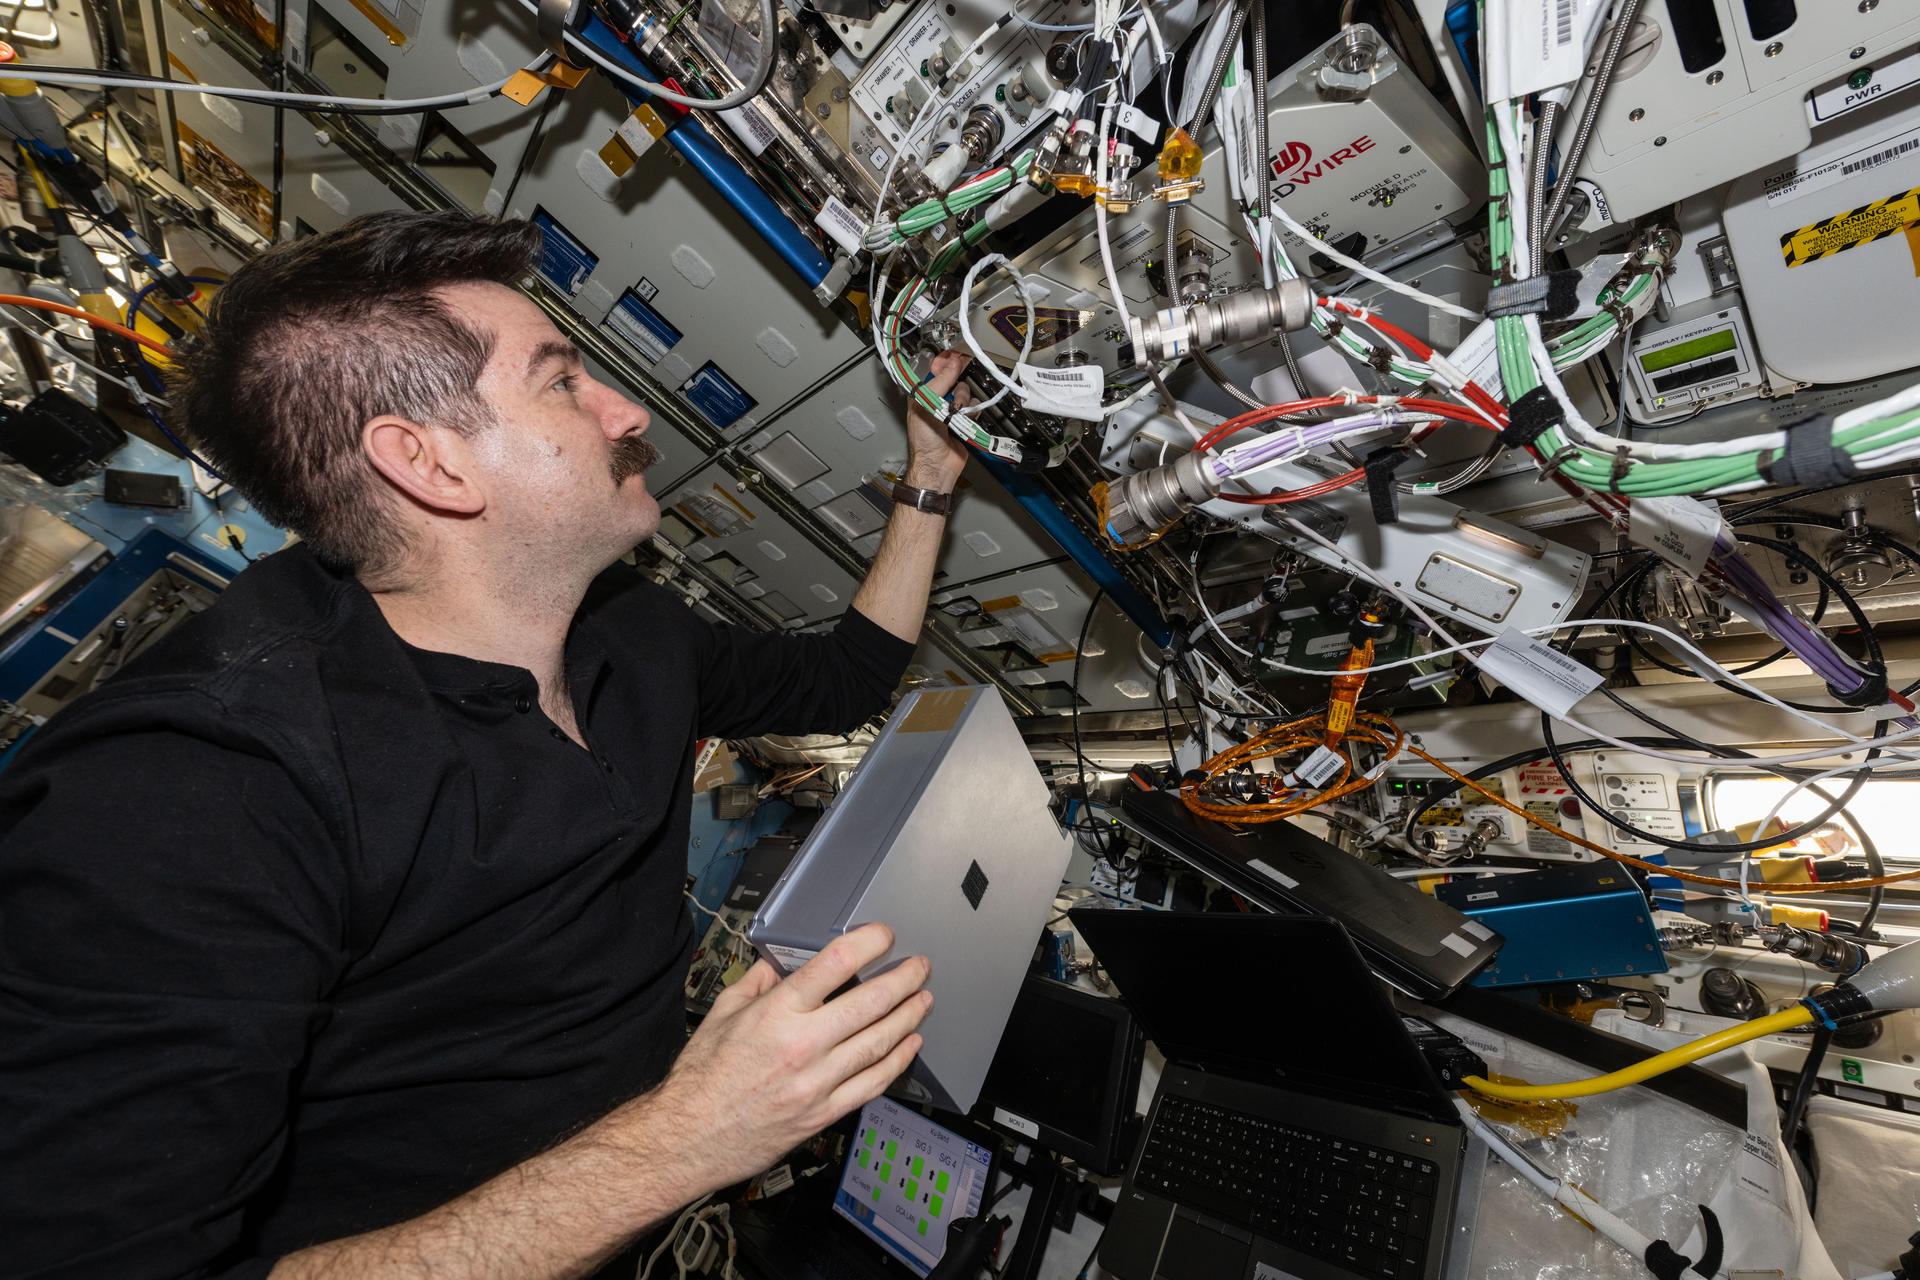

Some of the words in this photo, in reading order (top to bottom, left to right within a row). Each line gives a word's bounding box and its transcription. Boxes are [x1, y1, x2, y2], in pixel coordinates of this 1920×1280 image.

[908, 26, 927, 47] DRAWER
[928, 28, 941, 43] POWER
[1008, 56, 1023, 70] POWER
[874, 65, 892, 86] DRAWER
[893, 68, 905, 81] POWER
[1845, 84, 1881, 105] PWR
[1124, 111, 1132, 123] 3
[1270, 135, 1377, 203] DWIRE
[1764, 168, 1798, 187] Polar
[1350, 177, 1391, 202] MODULE
[1766, 184, 1781, 196] P/N
[1767, 190, 1782, 201] S/N
[1783, 185, 1798, 194] 017
[1802, 234, 1826, 245] WHEN
[1826, 215, 1881, 236] PERFORMING
[1882, 206, 1907, 217] COLD
[1818, 206, 1887, 235] WARNING
[1807, 231, 1858, 251] OPERATIONS
[1858, 221, 1890, 234] BELOW
[1809, 246, 1826, 255] USE
[1827, 238, 1850, 249] HAND
[1850, 220, 1904, 241] PROTECTION
[1813, 229, 1852, 245] STOWAGE
[1853, 214, 1896, 231] HANDLING
[1125, 248, 1154, 268] POWER
[1652, 336, 1680, 348] DISPLAY
[1685, 326, 1713, 339] KEYPAD
[1711, 379, 1736, 390] ERROR
[1667, 392, 1688, 401] COMM
[1463, 1036, 1498, 1053] Sample
[868, 1112, 880, 1126] S/G
[1009, 1117, 1020, 1127] MON
[889, 1124, 901, 1138] S/G
[915, 1139, 926, 1153] S/G
[1757, 1136, 1767, 1148] Bed
[939, 1153, 951, 1167] S/G
[908, 1211, 916, 1224] LAN
